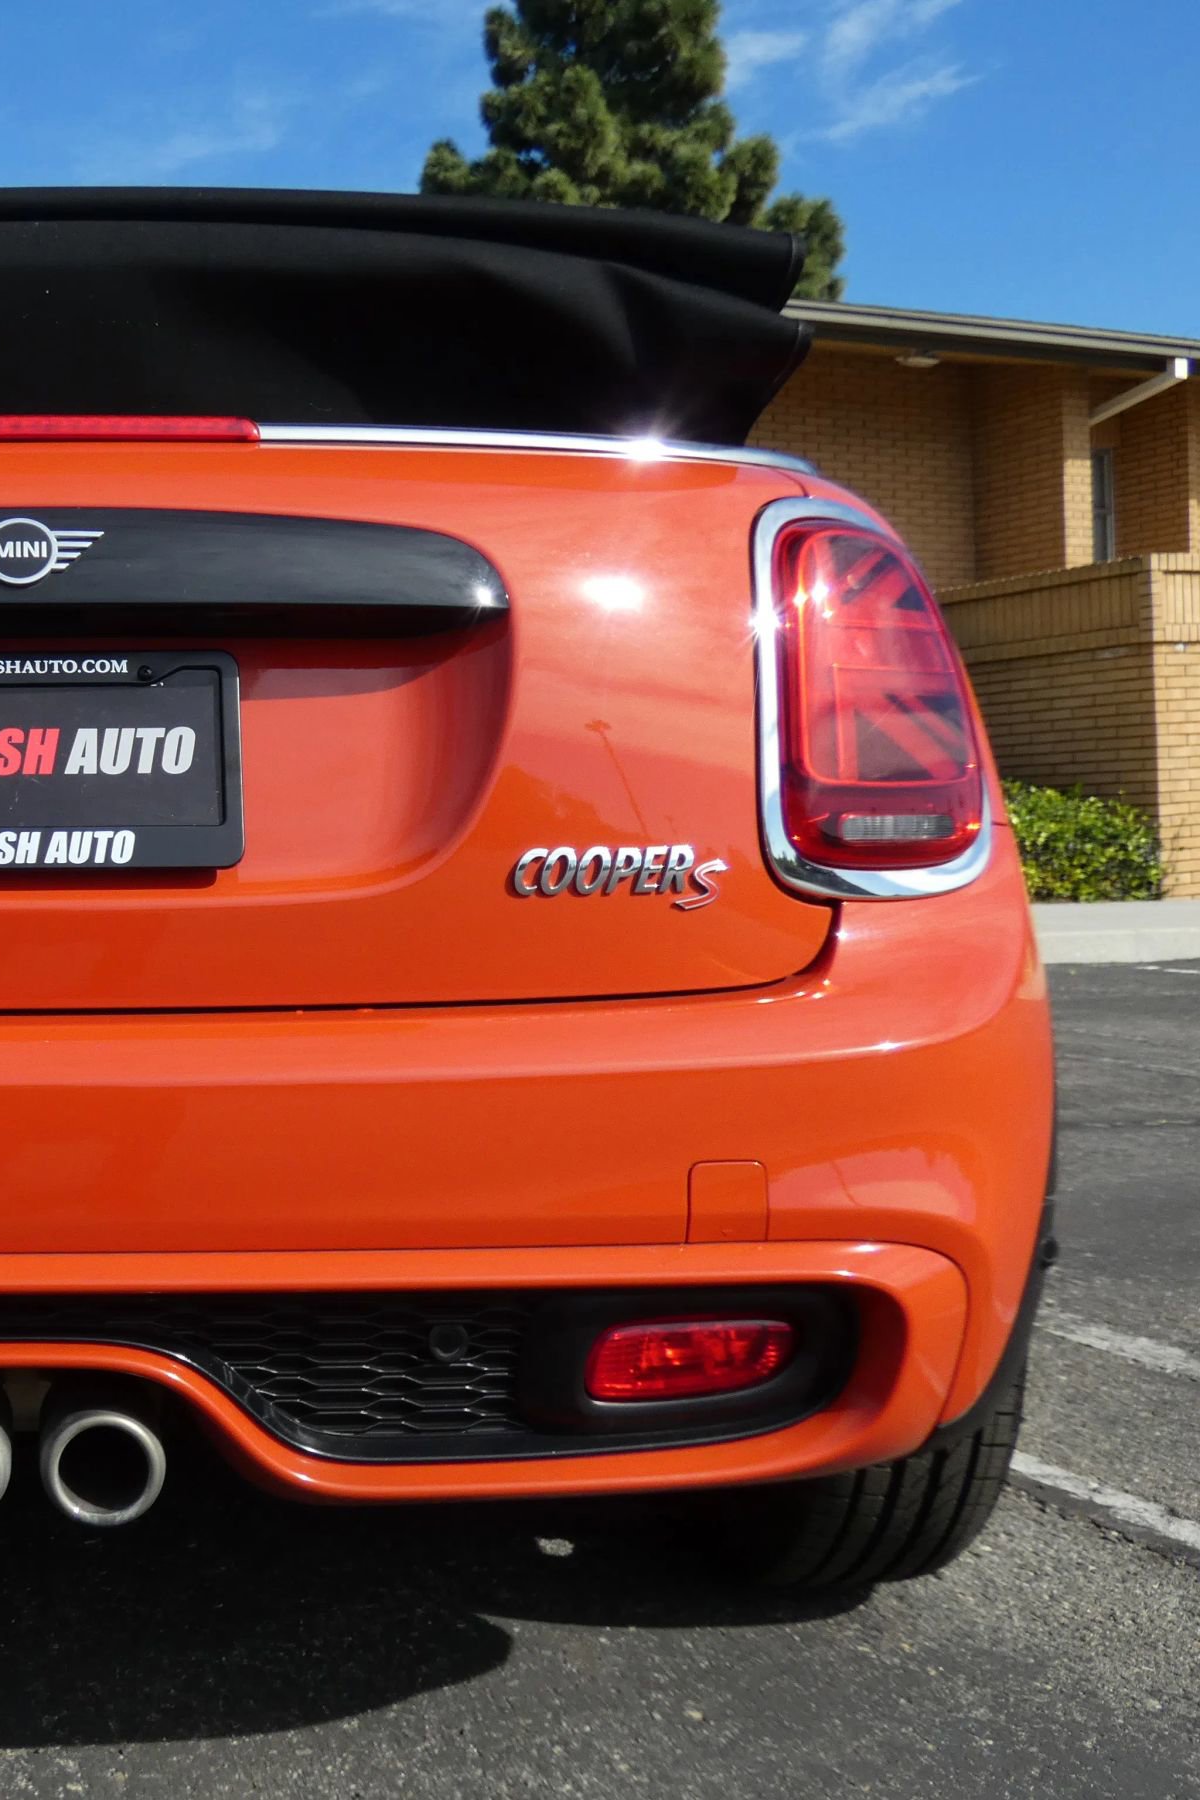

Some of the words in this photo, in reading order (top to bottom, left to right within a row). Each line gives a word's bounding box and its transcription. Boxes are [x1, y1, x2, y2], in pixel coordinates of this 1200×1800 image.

[64, 725, 196, 775] AUTO
[44, 829, 136, 865] AUTO
[513, 844, 695, 896] COOPER
